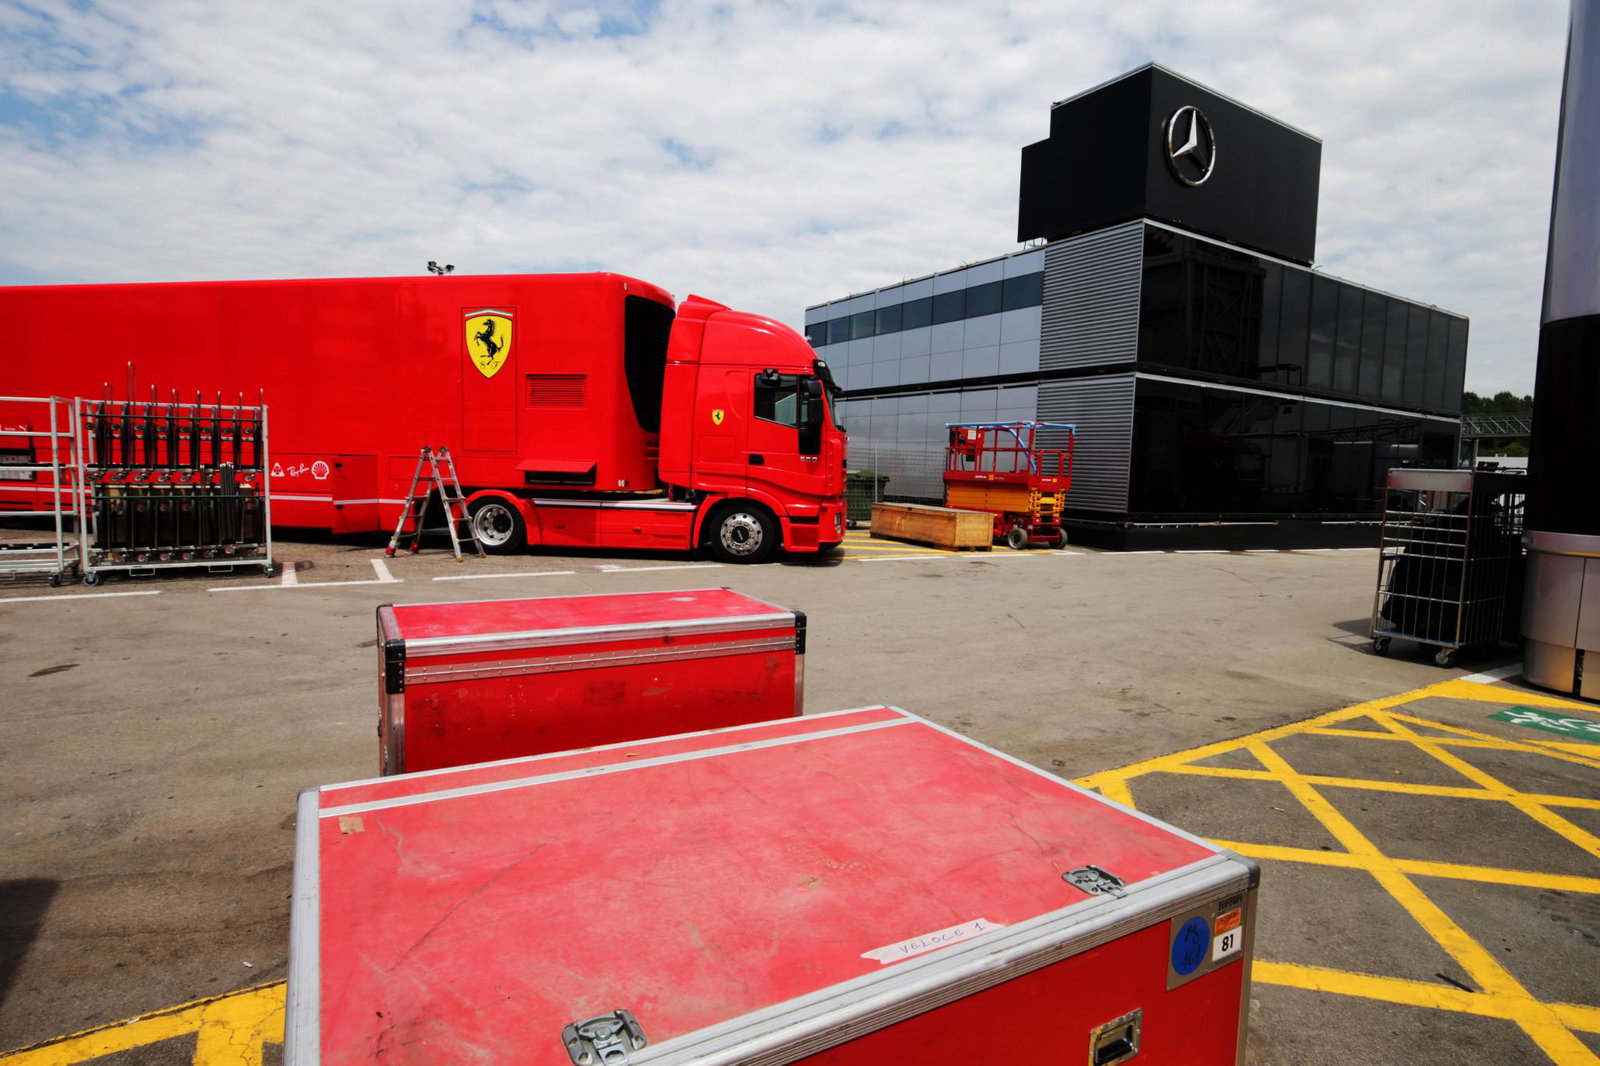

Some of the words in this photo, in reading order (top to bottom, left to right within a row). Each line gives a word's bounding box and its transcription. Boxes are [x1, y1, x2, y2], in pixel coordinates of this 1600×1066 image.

[899, 928, 964, 954] VELOCE
[974, 922, 986, 932] 1
[1221, 933, 1235, 952] 81
